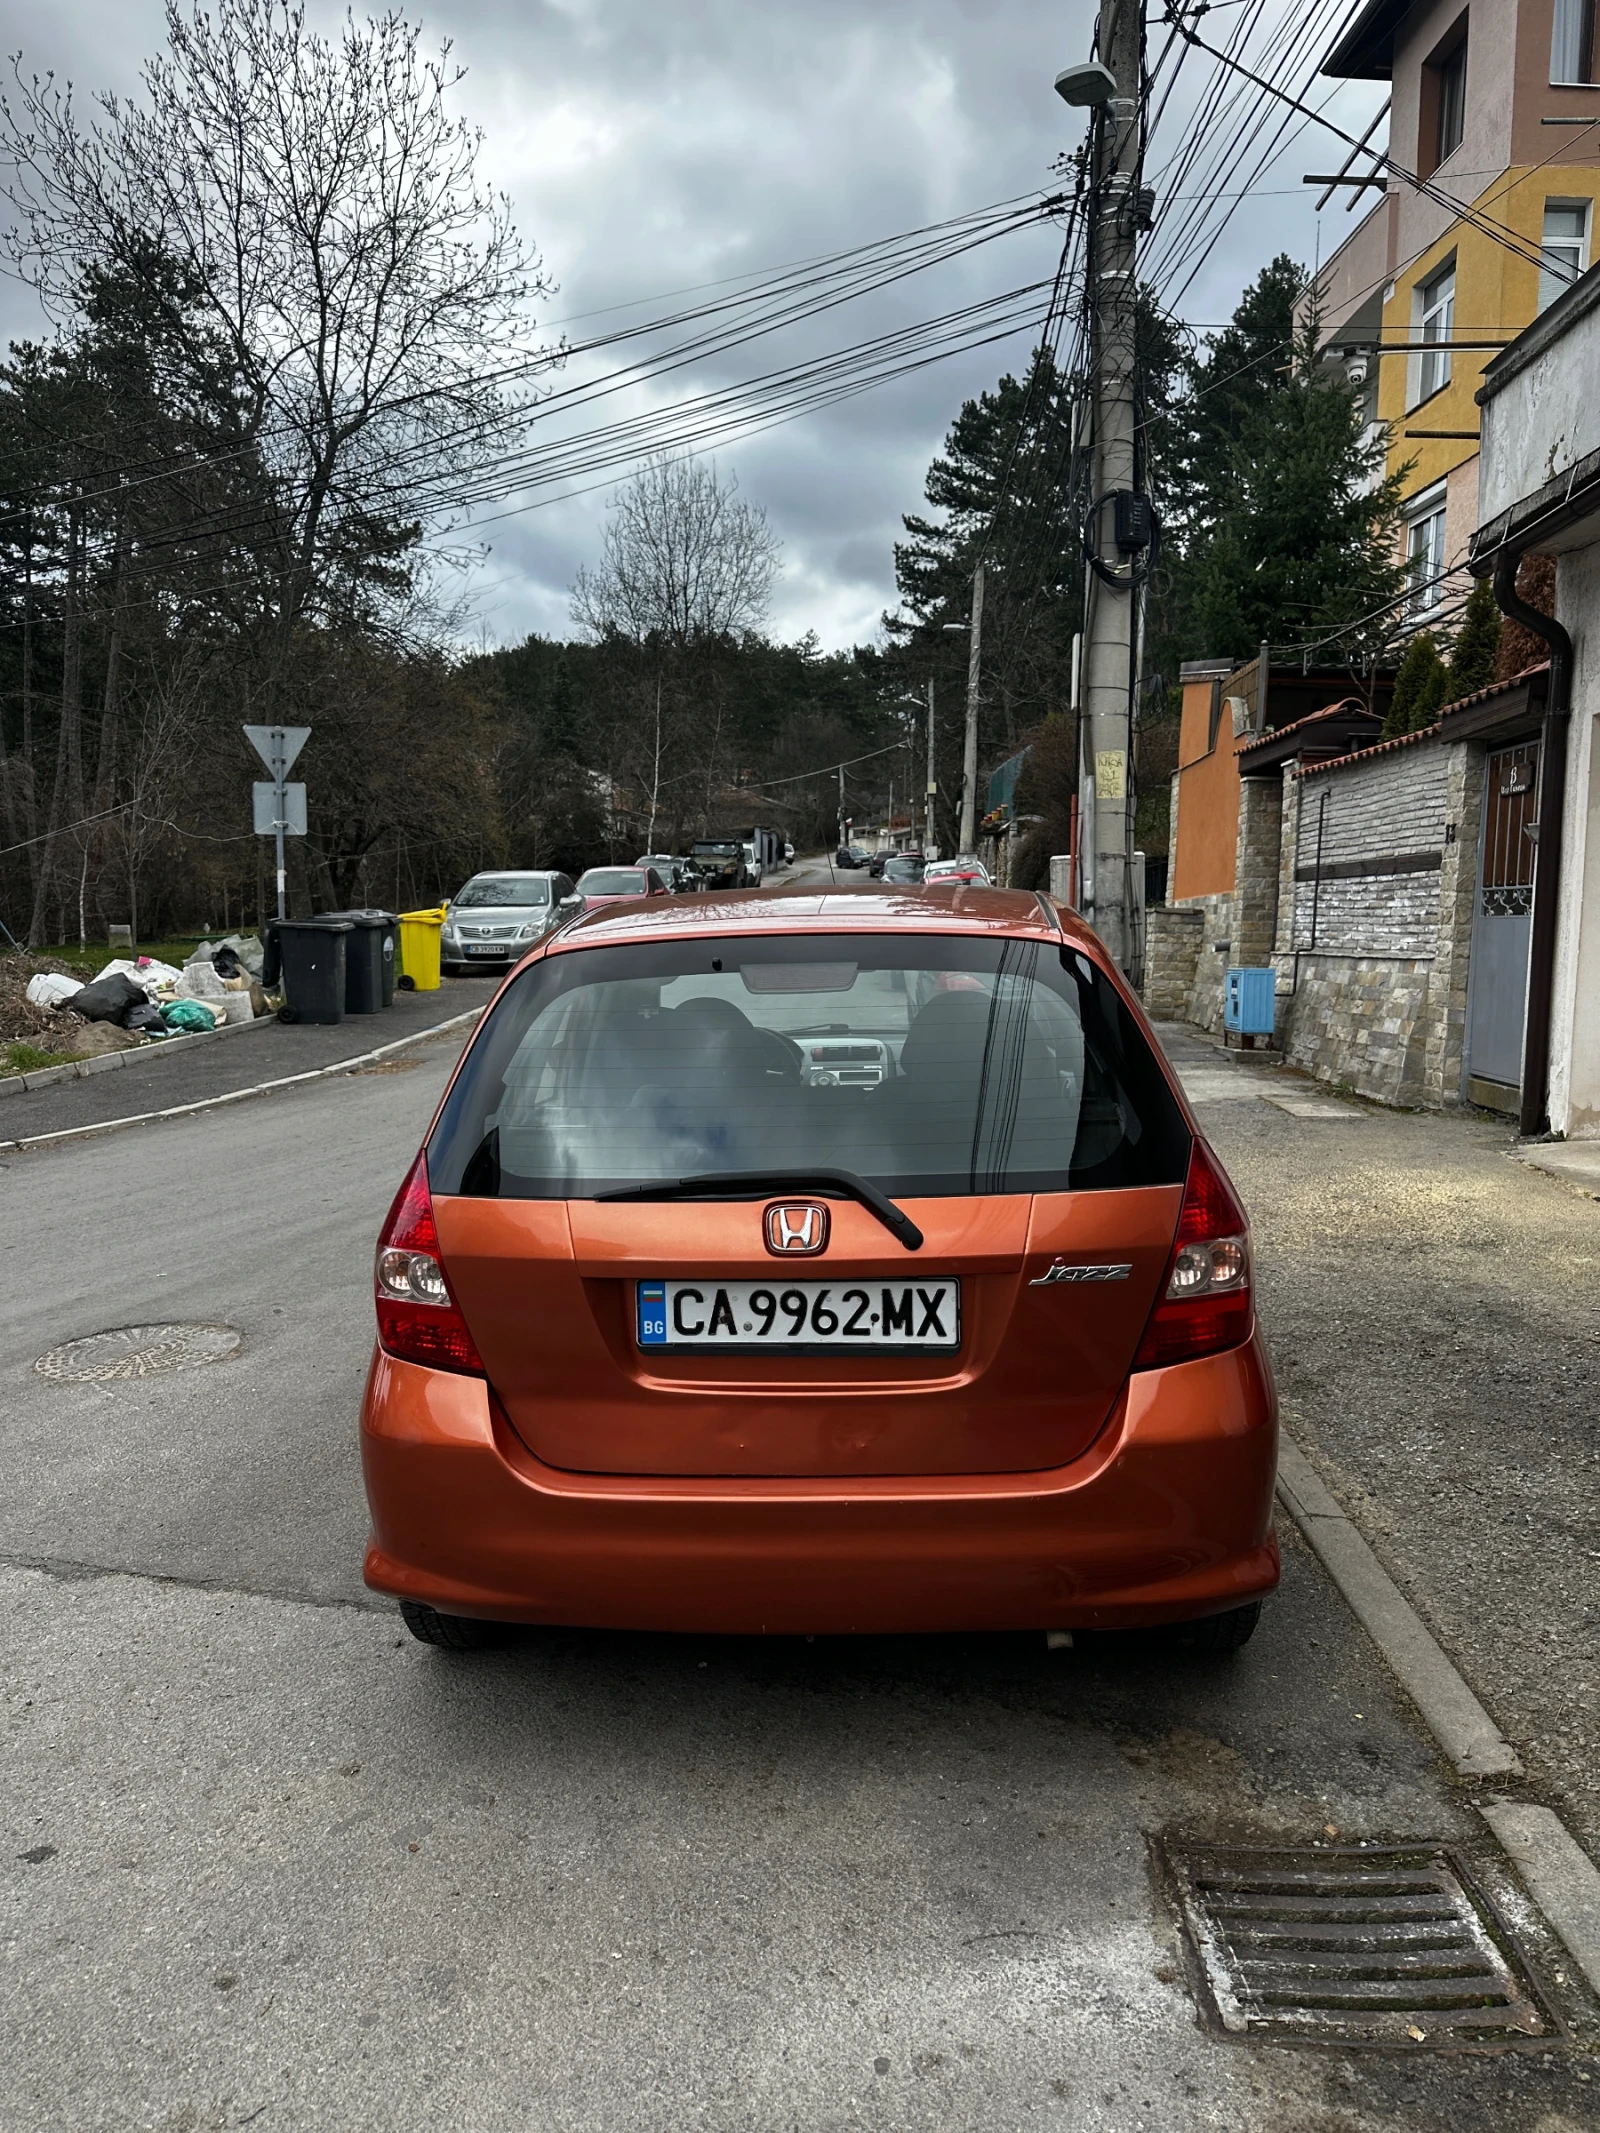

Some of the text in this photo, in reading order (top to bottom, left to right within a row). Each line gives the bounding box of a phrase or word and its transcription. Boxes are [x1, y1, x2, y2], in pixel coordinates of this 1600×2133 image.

[643, 1321, 664, 1334] BG
[673, 1288, 948, 1337] CA 9962 MX
